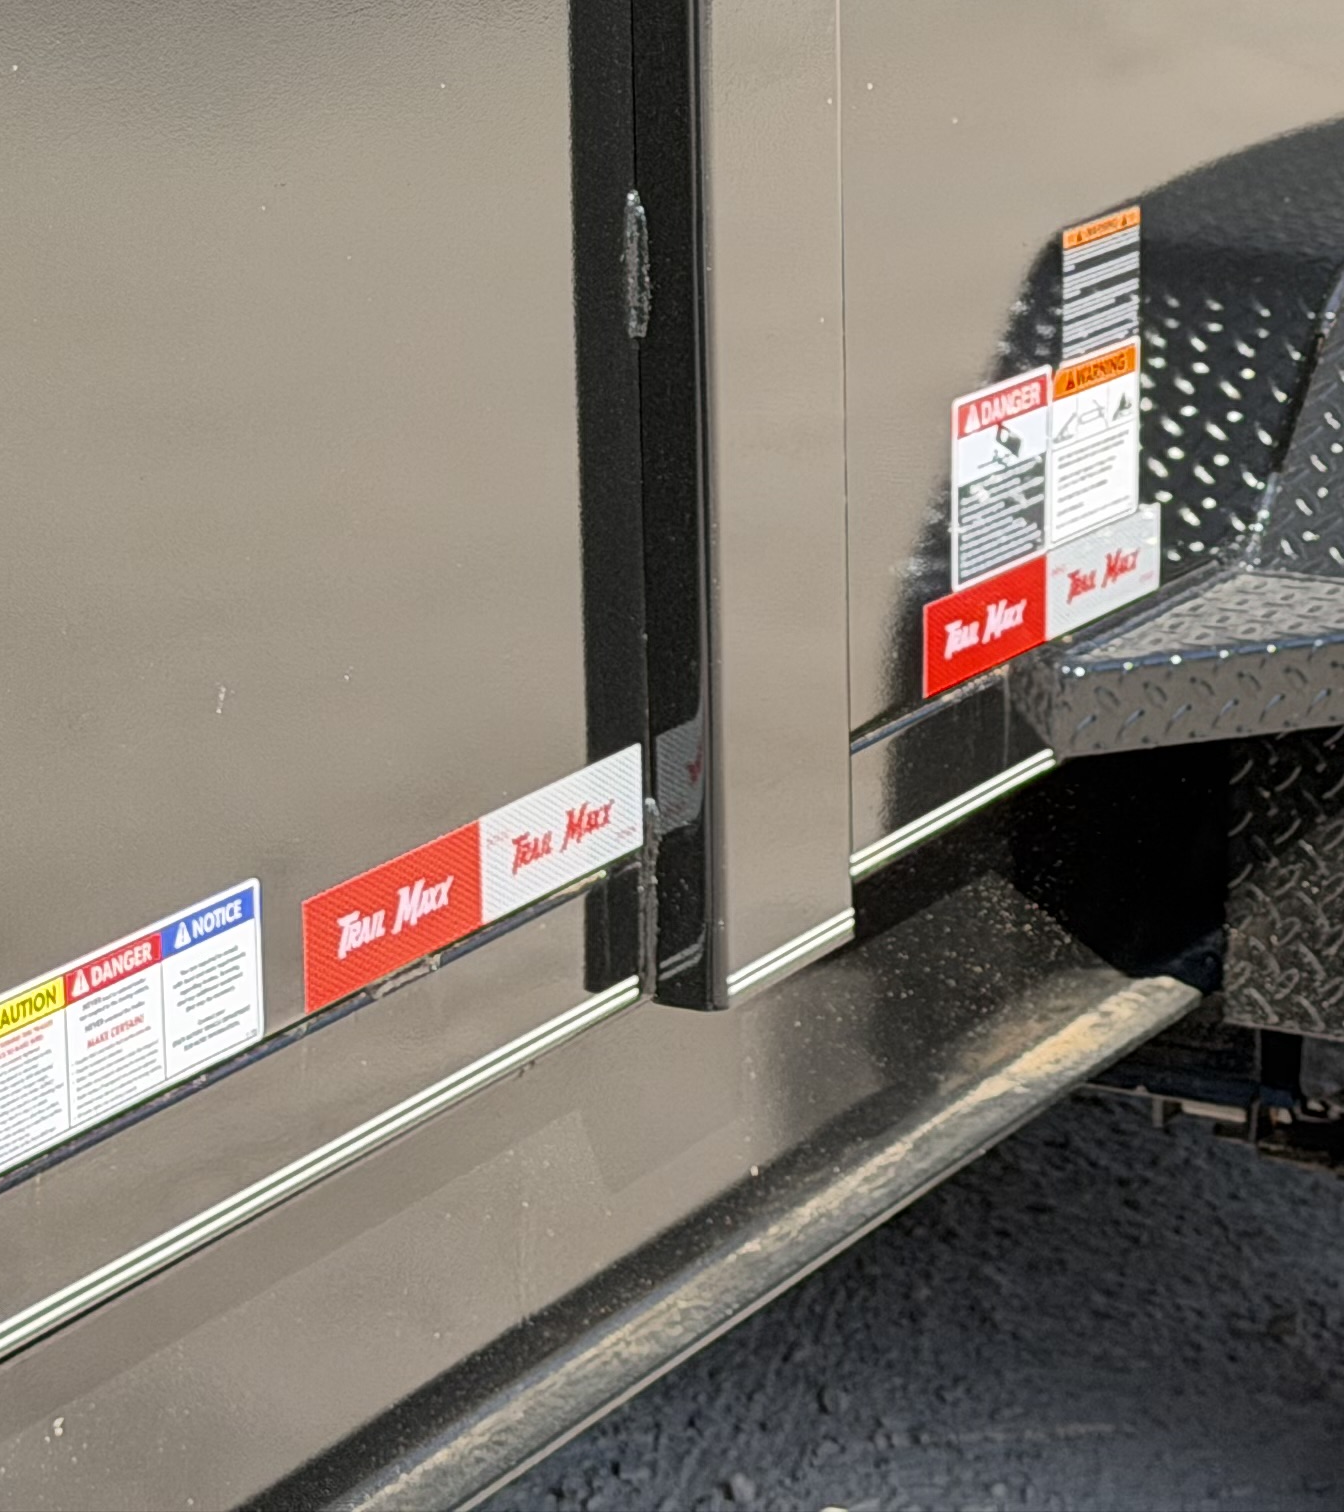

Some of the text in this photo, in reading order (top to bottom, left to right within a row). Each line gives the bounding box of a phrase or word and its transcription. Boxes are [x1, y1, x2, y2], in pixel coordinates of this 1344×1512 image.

[1076, 353, 1126, 387] WARNING
[981, 382, 1041, 422] DANGER
[512, 798, 615, 875] TRAIL MAXX
[192, 899, 243, 938] NOTICE
[337, 876, 454, 960] TRAIL MAXX
[90, 941, 152, 987] DANGER
